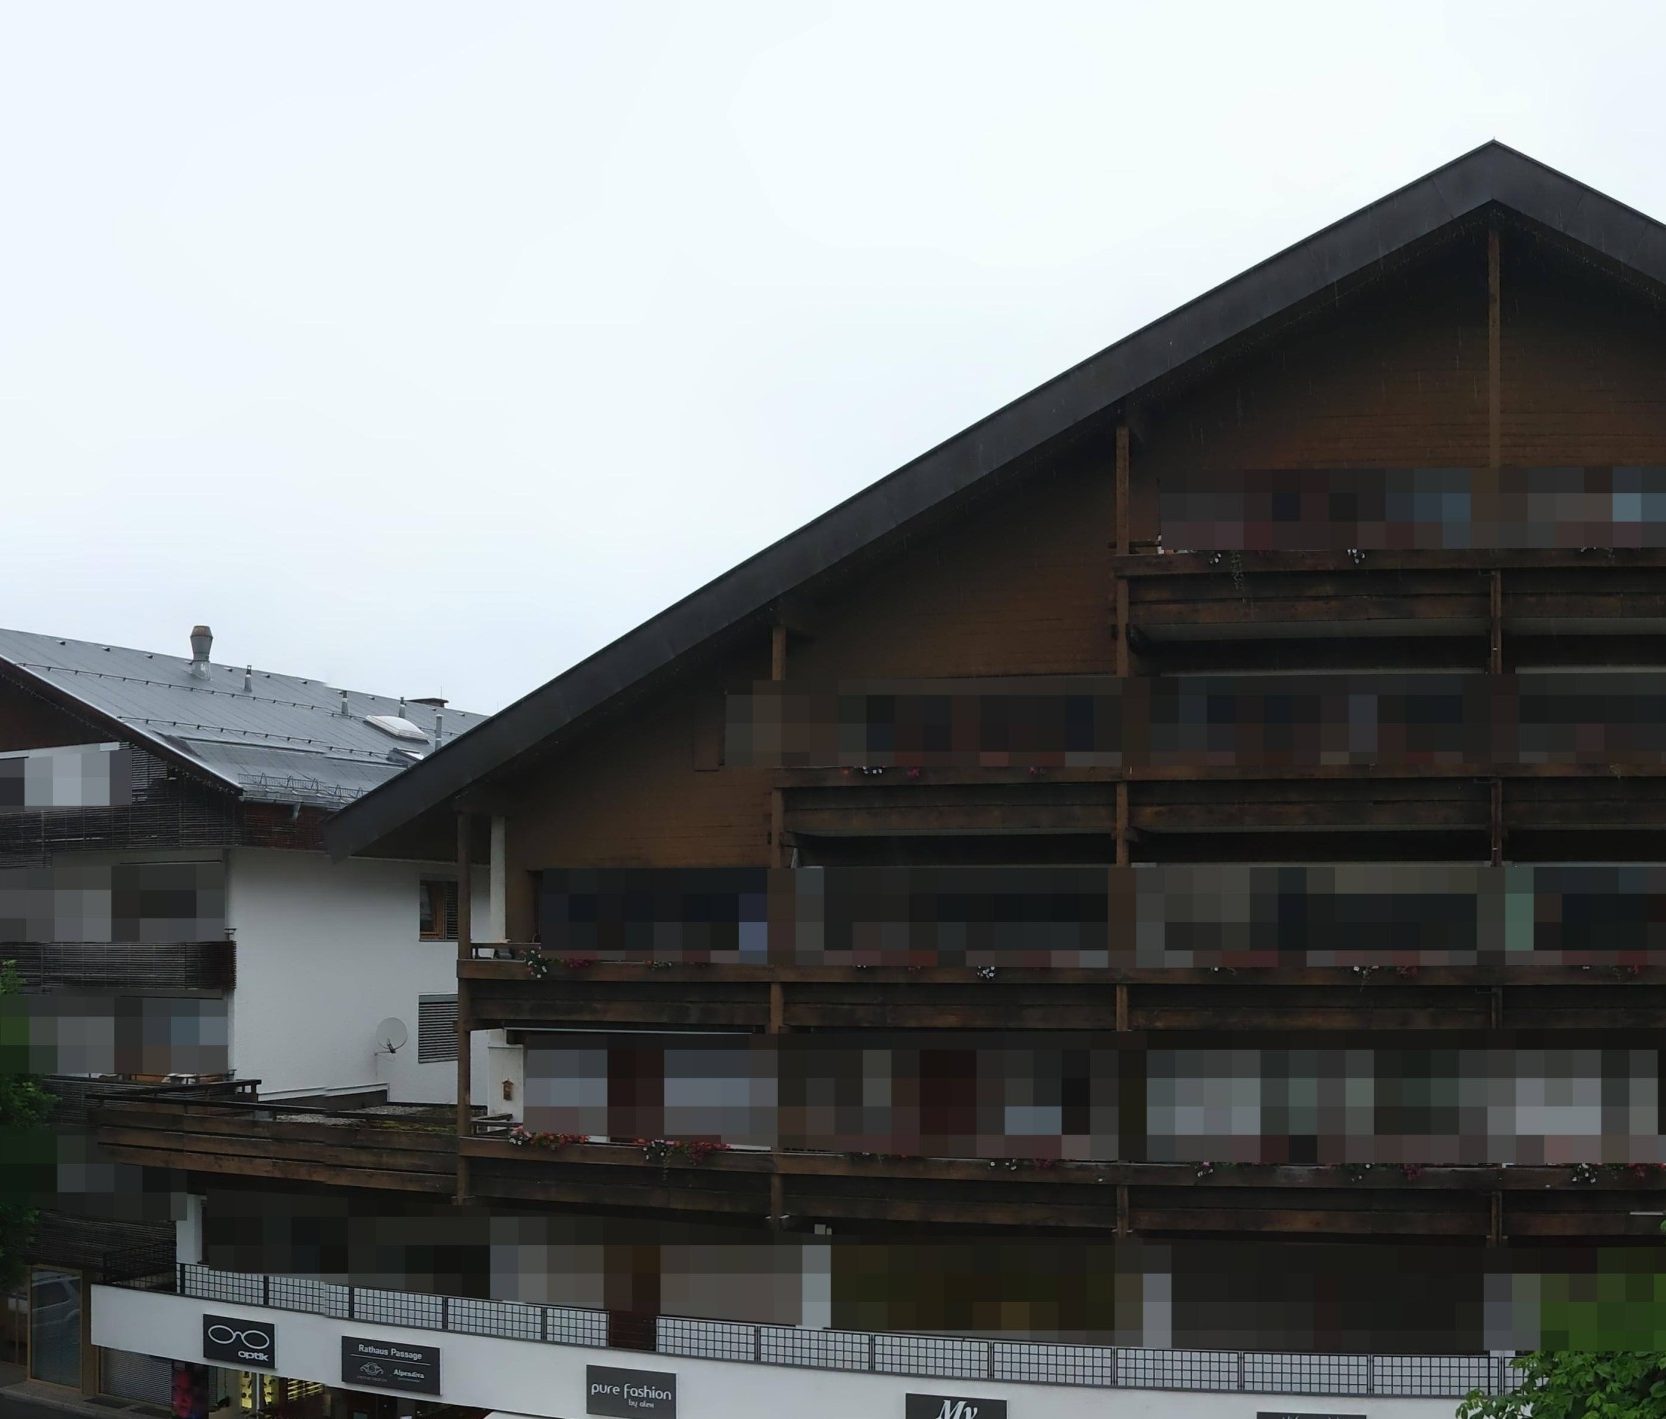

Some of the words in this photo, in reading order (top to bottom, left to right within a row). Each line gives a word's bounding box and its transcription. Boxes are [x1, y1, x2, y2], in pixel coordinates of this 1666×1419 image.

[237, 1350, 269, 1362] optik
[358, 1344, 388, 1356] Rathaus
[390, 1348, 422, 1361] Passage
[591, 1383, 620, 1395] pure
[623, 1383, 672, 1401] fashion
